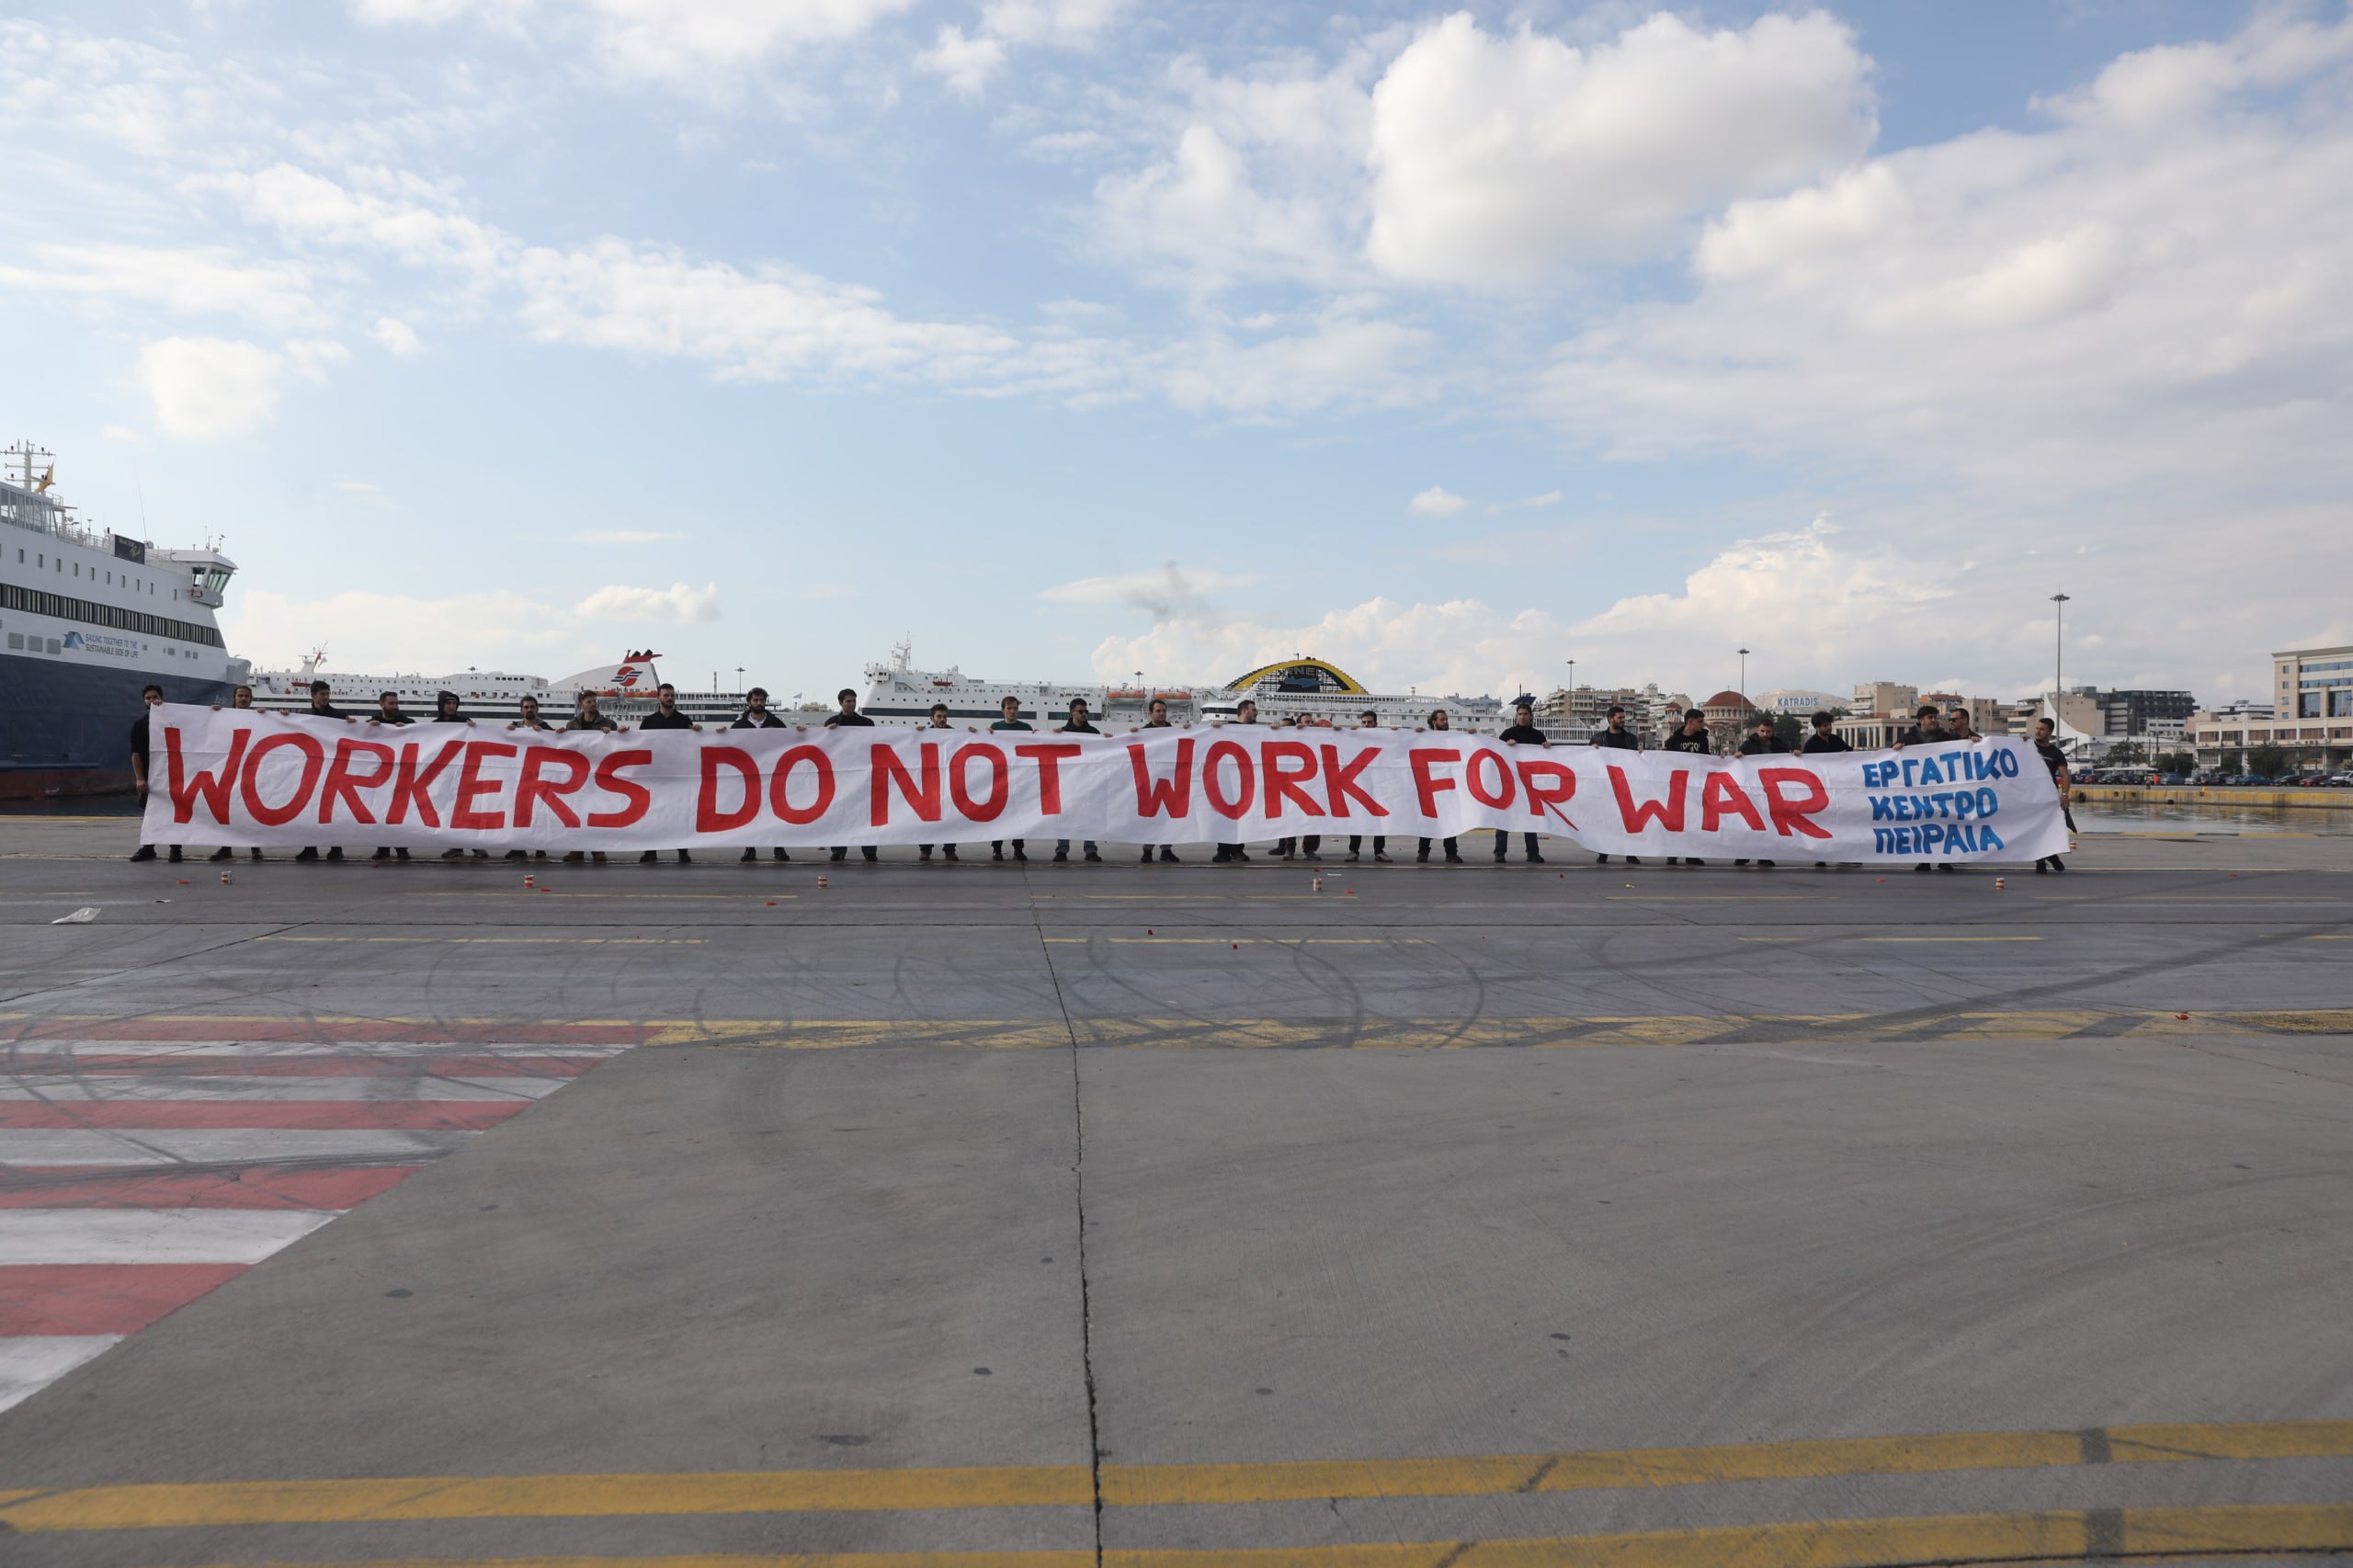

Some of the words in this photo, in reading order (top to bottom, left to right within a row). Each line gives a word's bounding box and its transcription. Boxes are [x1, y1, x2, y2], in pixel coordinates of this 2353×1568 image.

[85, 643, 114, 654] SUSTAINABLE
[115, 648, 124, 656] SIDE
[131, 650, 139, 659] LIFE
[103, 636, 123, 646] TOGETHER
[1778, 698, 1818, 707] KATRADIS
[165, 728, 653, 830] WORKERS
[697, 744, 835, 833] DO
[870, 743, 1082, 826] NOT
[1127, 738, 1390, 820] WORK
[1409, 748, 1580, 832] FOR
[1607, 767, 1833, 839] WAR
[1862, 748, 2019, 789] ΕΡΓΑΤΙΚΟ
[1868, 787, 1999, 822] ΚΕΝΤΡΟ
[1872, 824, 2005, 855] ΠΕΙΡΑΙΑ
